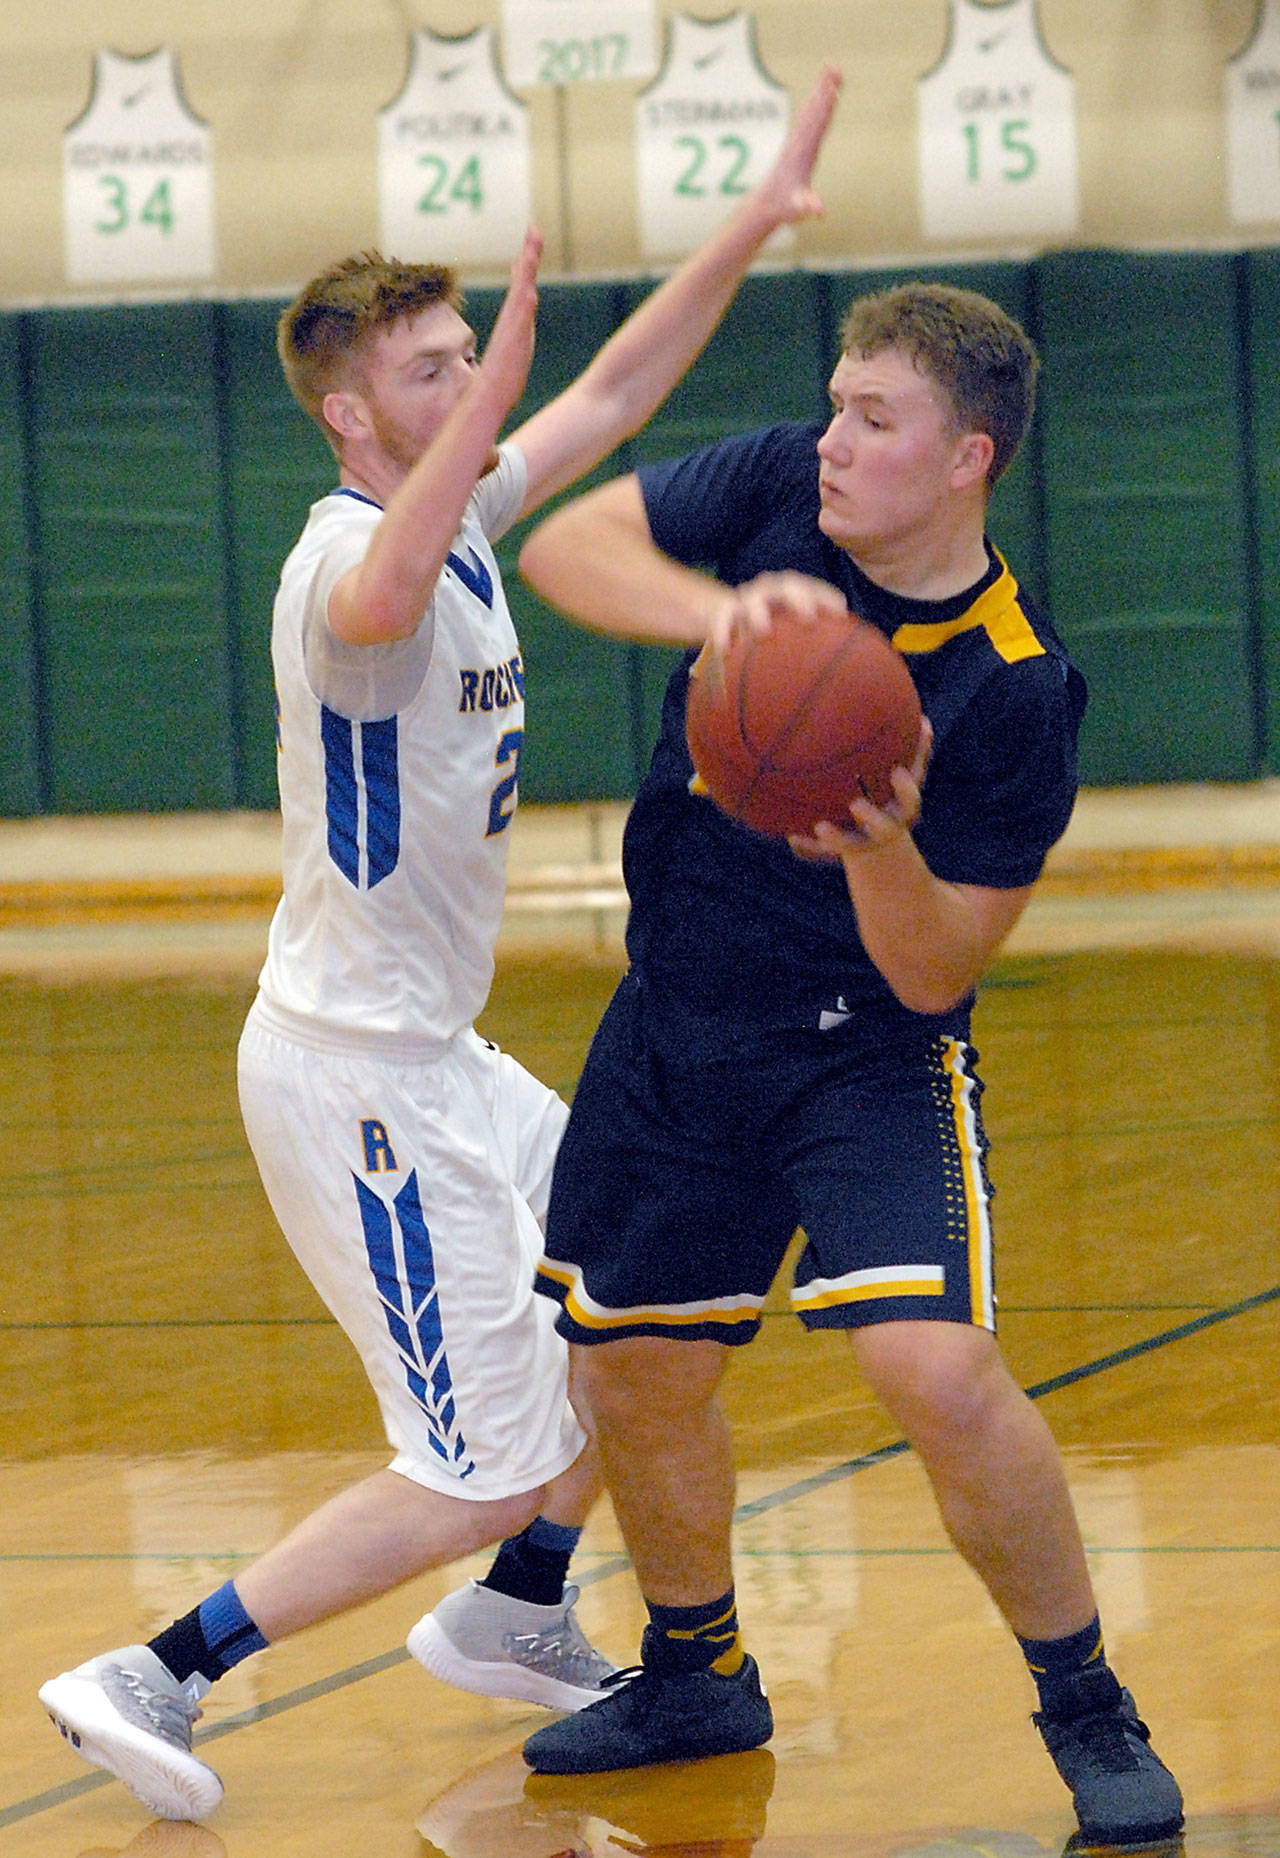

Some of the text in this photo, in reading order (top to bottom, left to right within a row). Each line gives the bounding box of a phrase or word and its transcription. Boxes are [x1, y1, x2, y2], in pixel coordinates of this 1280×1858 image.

[538, 32, 627, 80] 2017
[674, 134, 751, 196] 22
[964, 120, 1037, 183] 15
[95, 174, 174, 236] 34
[417, 153, 483, 215] 24
[358, 1118, 399, 1174] R
